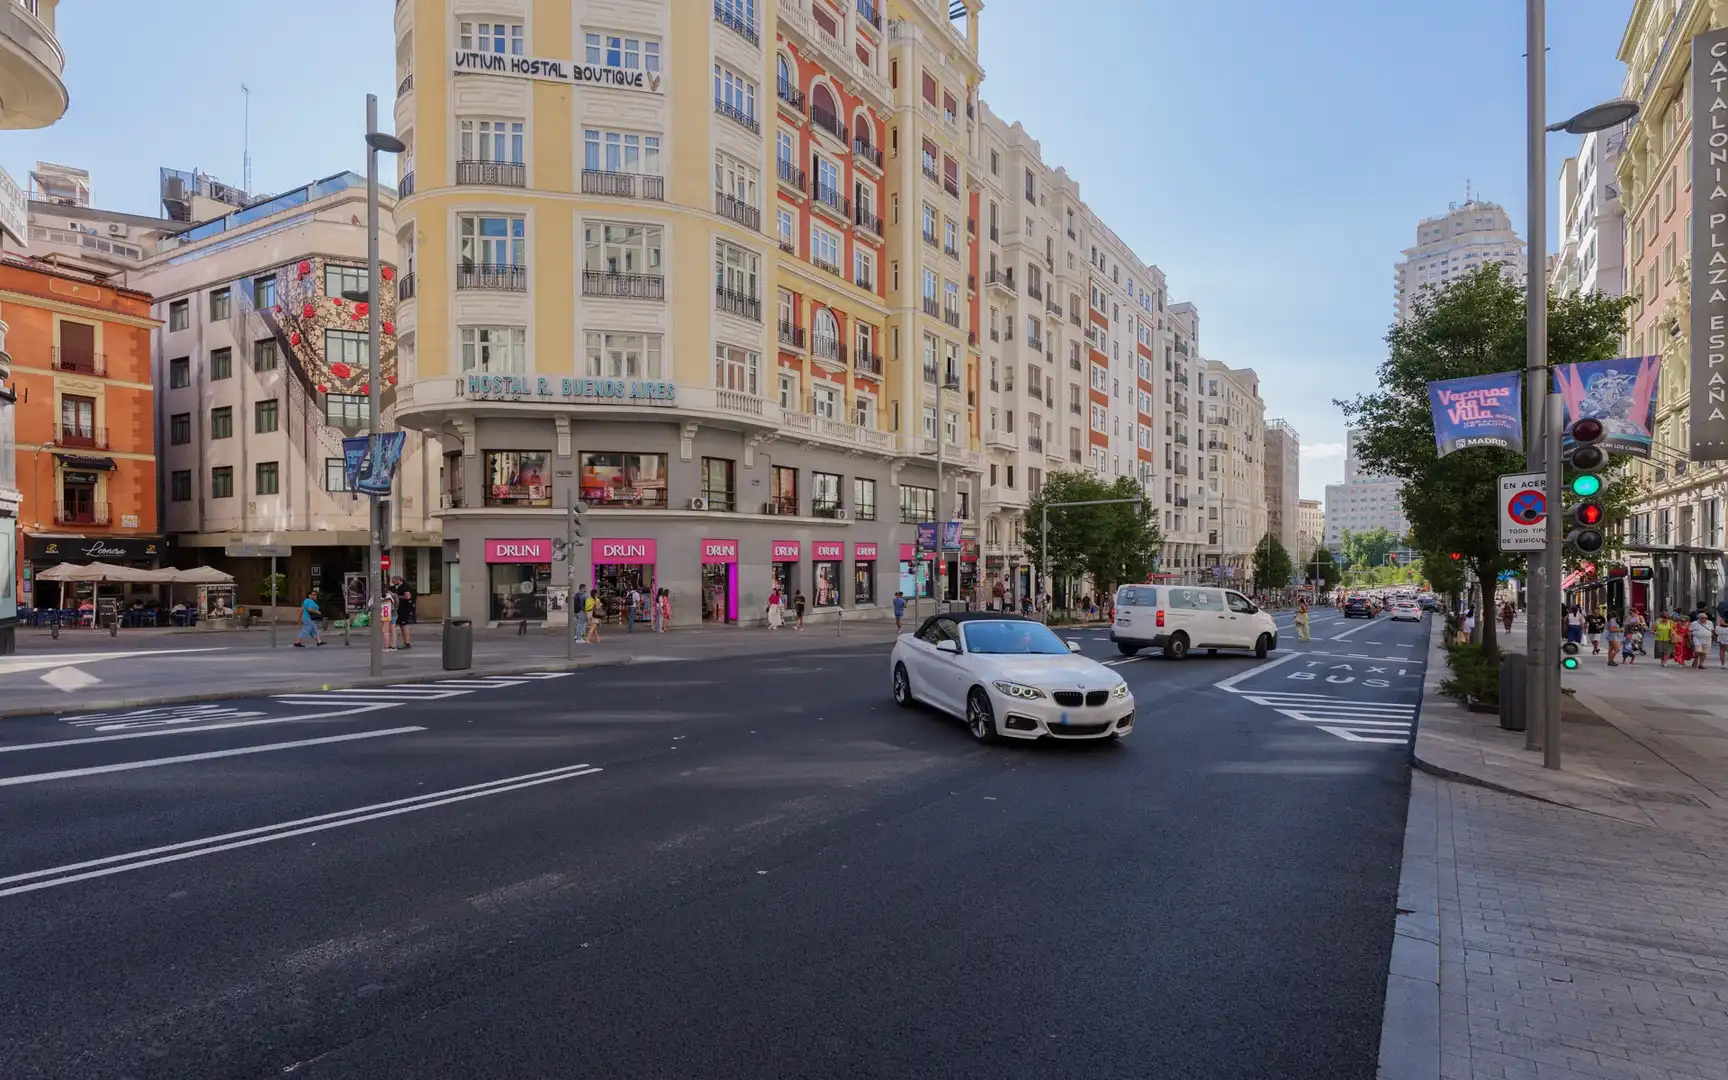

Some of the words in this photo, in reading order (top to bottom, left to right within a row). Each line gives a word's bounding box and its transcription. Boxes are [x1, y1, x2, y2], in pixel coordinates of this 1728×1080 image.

[455, 51, 506, 71] VITIUM
[511, 58, 567, 79] HOSTAL
[573, 64, 643, 87] BOUTIQUE
[1709, 42, 1728, 200] CATALONIA
[1708, 213, 1727, 302] PLAZA
[1708, 315, 1726, 421] ESPAÑA
[468, 375, 531, 395] HOSTAL
[537, 377, 553, 396] R.
[561, 378, 625, 397] BUENOS
[629, 381, 675, 400] AIRES
[1437, 387, 1509, 405] Veranos
[1480, 394, 1500, 406] la
[1448, 405, 1493, 425] Villa
[1468, 437, 1507, 447] MADRID
[1521, 480, 1546, 488] ACER
[496, 544, 540, 557] DRUNI
[603, 544, 645, 557] DRUNI
[706, 545, 735, 556] DRUNI
[775, 546, 798, 556] DRUNI
[818, 546, 839, 556] DRUNI
[857, 547, 876, 556] DRUNI
[1305, 660, 1407, 675] TAXI
[1286, 671, 1391, 688] BUS
